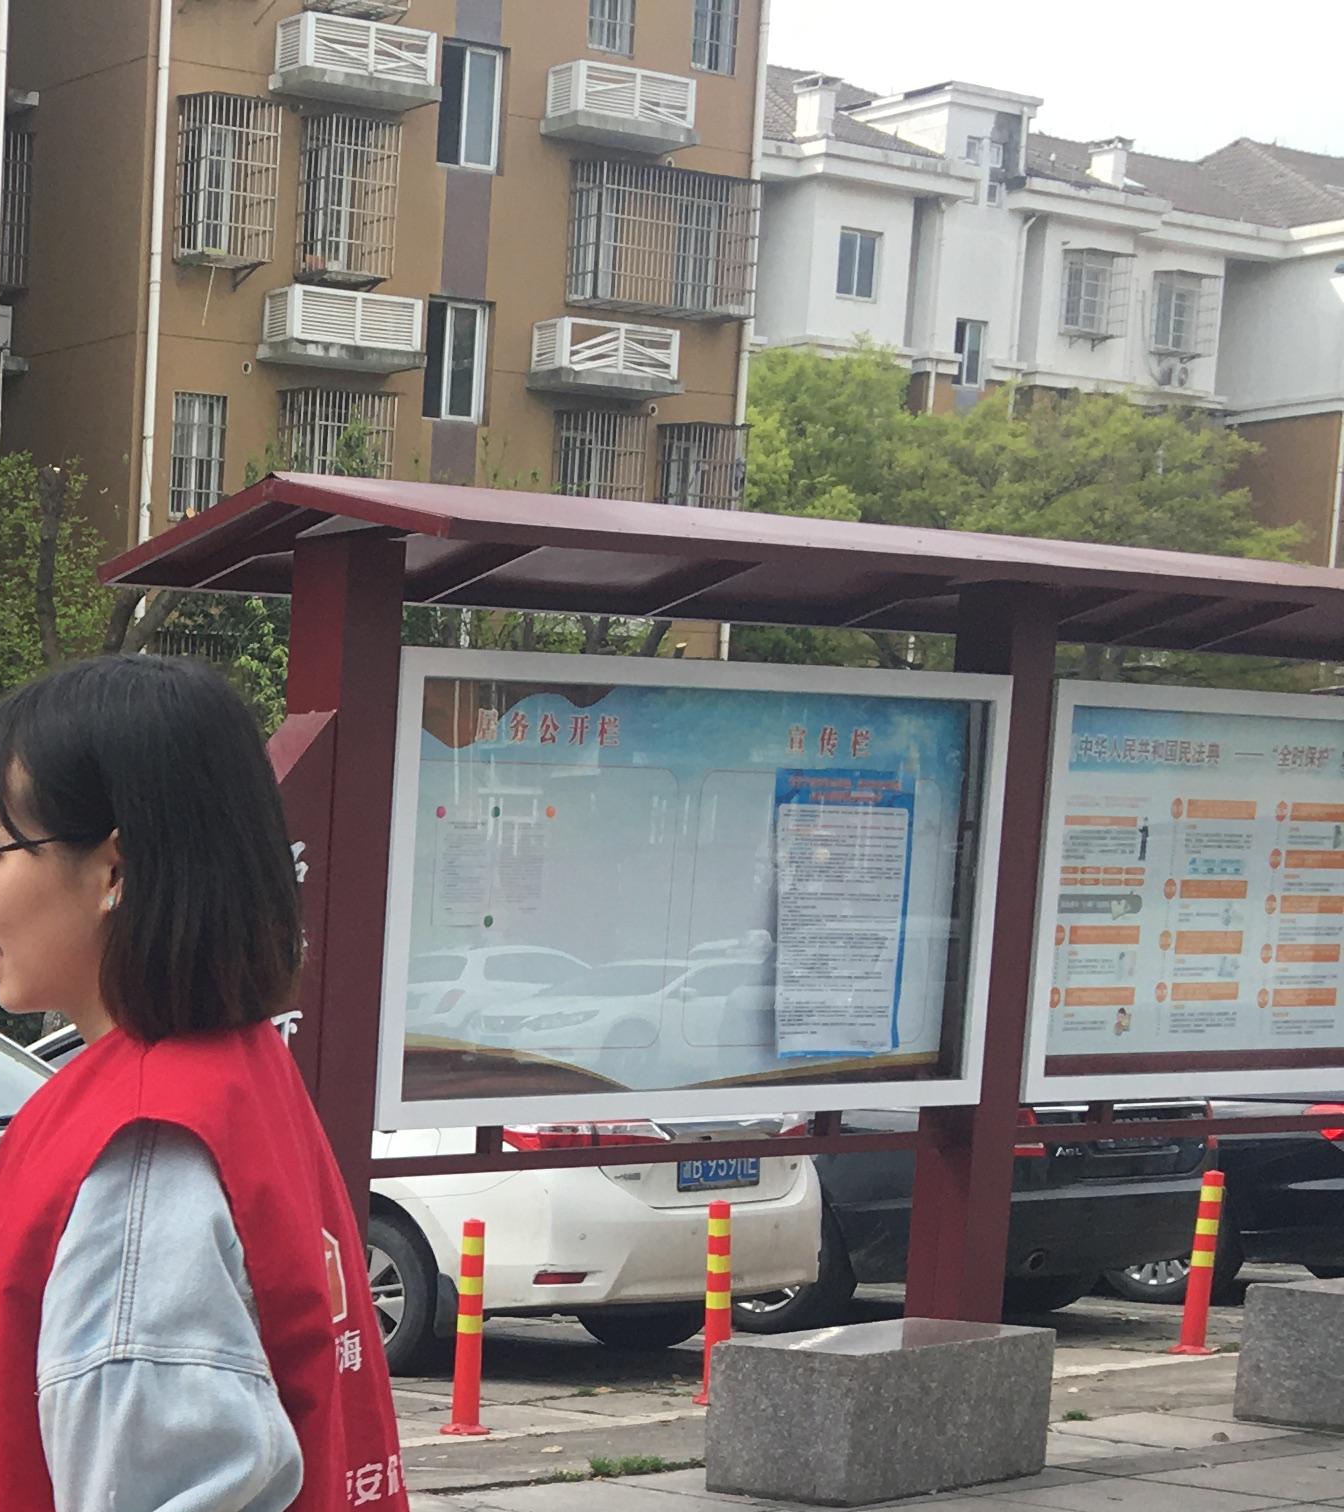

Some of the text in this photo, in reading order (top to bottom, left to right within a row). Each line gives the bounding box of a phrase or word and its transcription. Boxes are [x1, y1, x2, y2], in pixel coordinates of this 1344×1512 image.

[474, 707, 620, 747] 居务公开栏
[787, 724, 873, 758] 宣传栏
